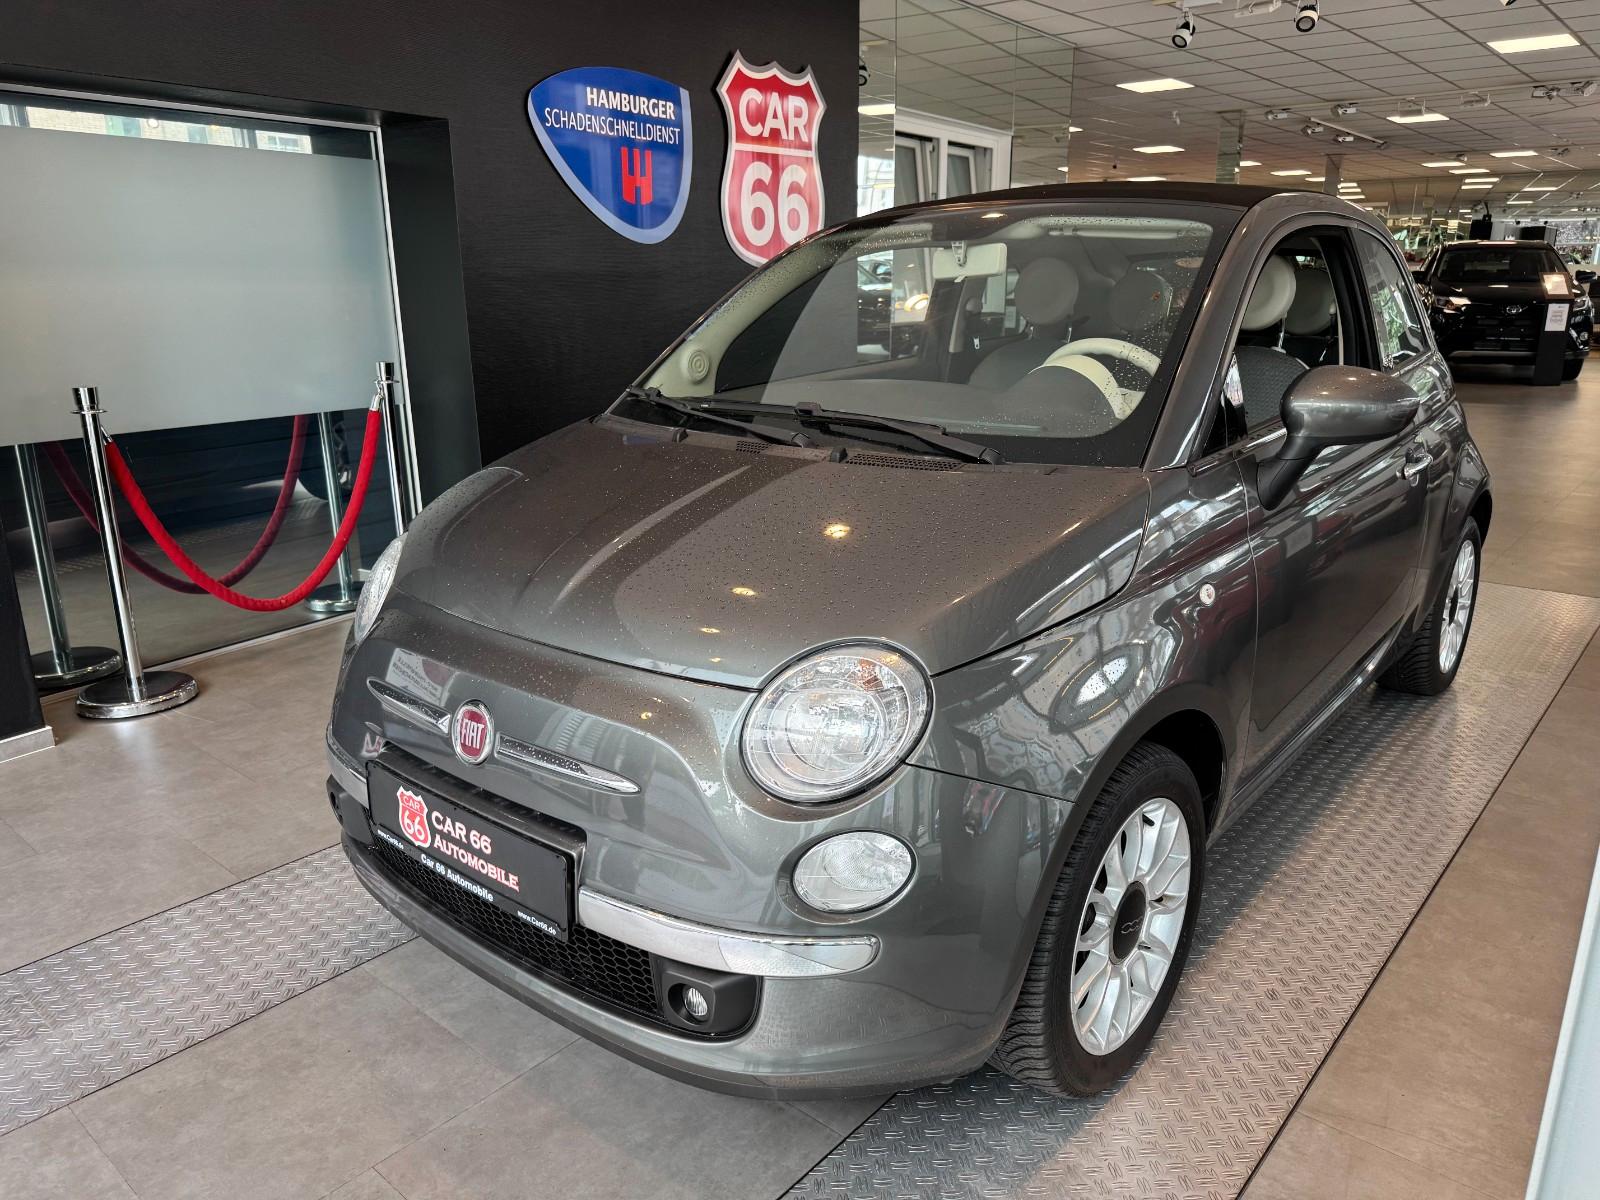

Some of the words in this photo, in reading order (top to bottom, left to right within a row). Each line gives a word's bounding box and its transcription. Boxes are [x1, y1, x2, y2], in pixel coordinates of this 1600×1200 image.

[586, 87, 675, 120] HAMBURGER
[739, 88, 809, 143] CAR
[544, 107, 680, 145] SCHADENSCHNELLDIENST
[740, 161, 810, 247] 66
[461, 718, 486, 749] FIAT
[402, 795, 421, 811] CAR
[403, 811, 425, 841] 66
[431, 810, 467, 842] CAR
[469, 829, 492, 855] 66
[421, 853, 435, 869] Car
[436, 862, 445, 875] 66
[447, 870, 494, 902] Automobile
[434, 835, 520, 893] AUTOMOBILE
